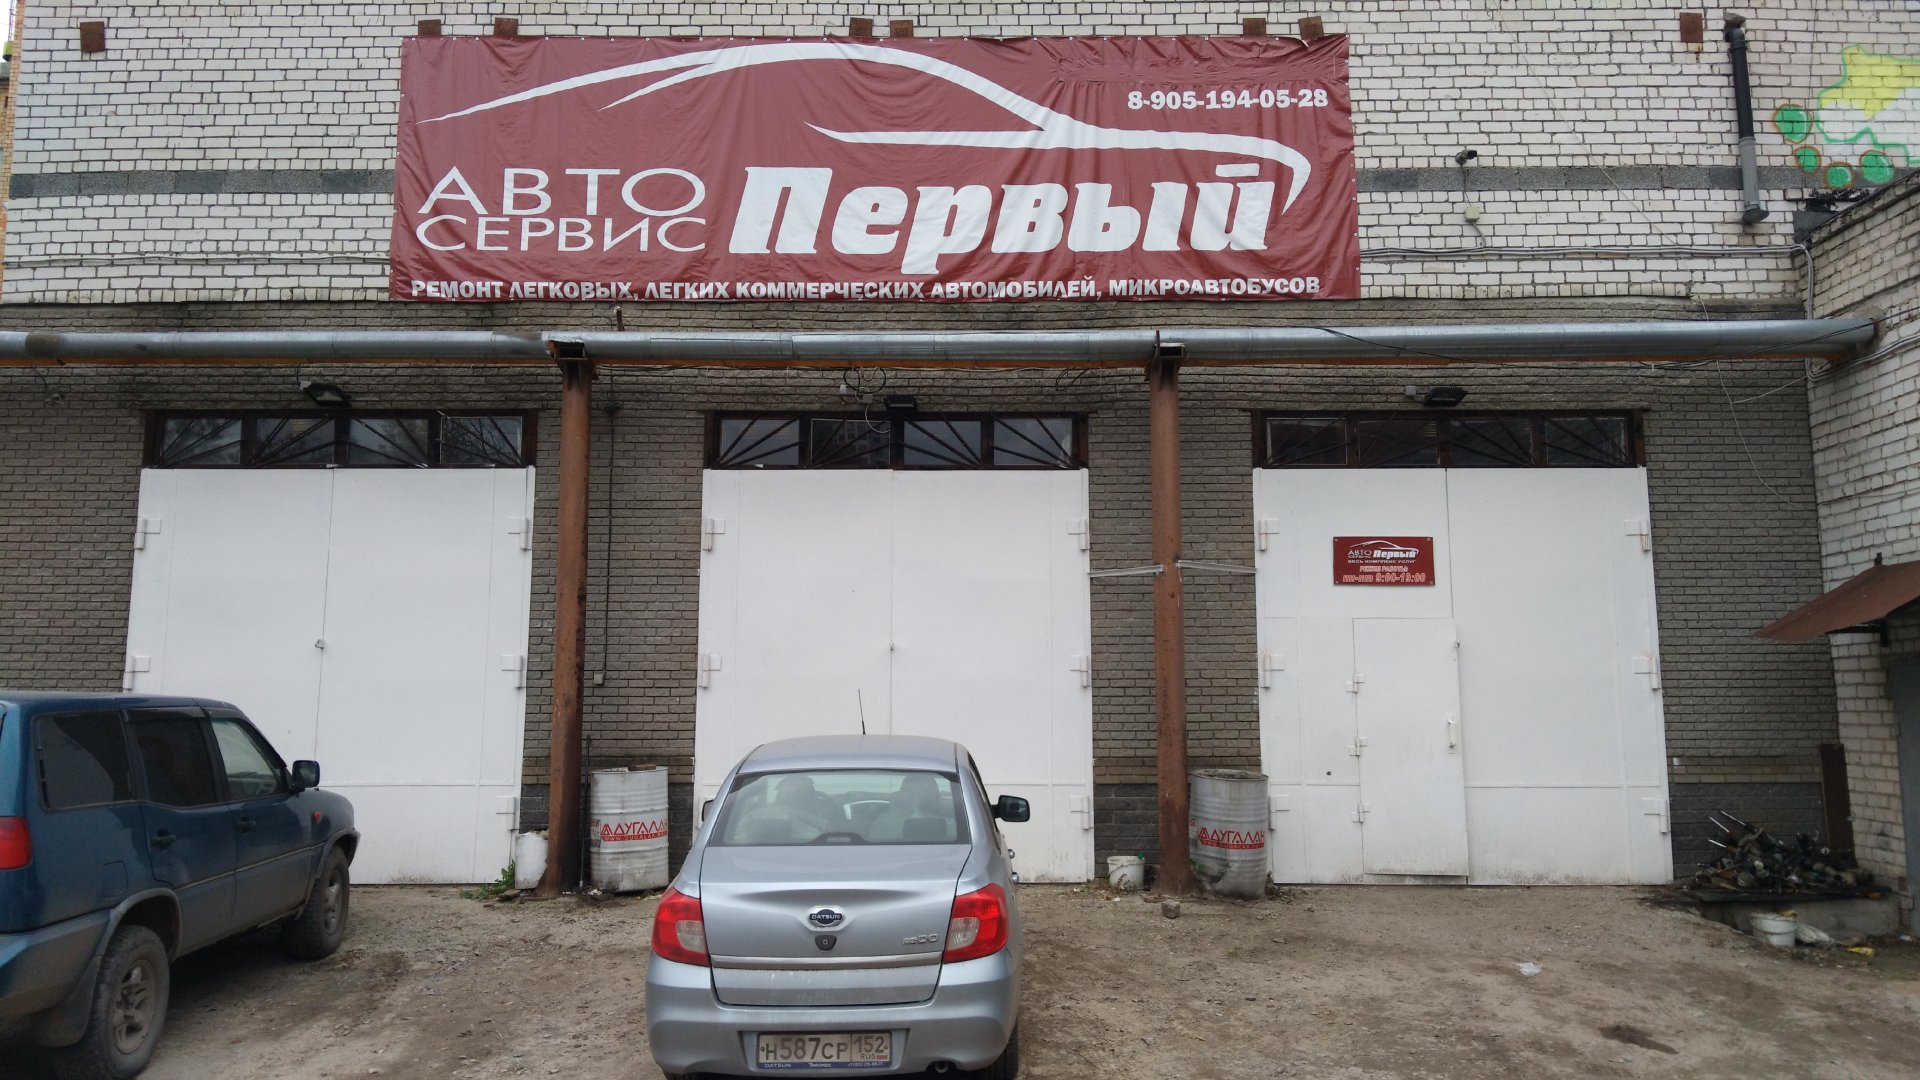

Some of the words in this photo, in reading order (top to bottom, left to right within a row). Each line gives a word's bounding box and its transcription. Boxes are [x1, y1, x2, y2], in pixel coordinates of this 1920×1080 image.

[1127, 88, 1329, 111] 8-905-194-05-28
[416, 165, 706, 216] АВТО
[728, 162, 1276, 275] Первый
[415, 216, 706, 253] СЕРВИС
[411, 280, 504, 298] РЕМОНТ
[509, 281, 638, 300] ЛЕГКОВЫХ,
[645, 281, 730, 299] ЛЕГКИХ
[736, 281, 925, 299] КОММЕРЧЕСКИХ
[930, 275, 1102, 299] АВТОМОБИЛЕЙ,
[1109, 276, 1320, 296] МИКРОАВТОБУСОВ
[1373, 549, 1417, 560] Первый
[765, 1037, 849, 1061] Н587СР
[853, 1036, 885, 1054] 152
[860, 1053, 876, 1061] RUS
